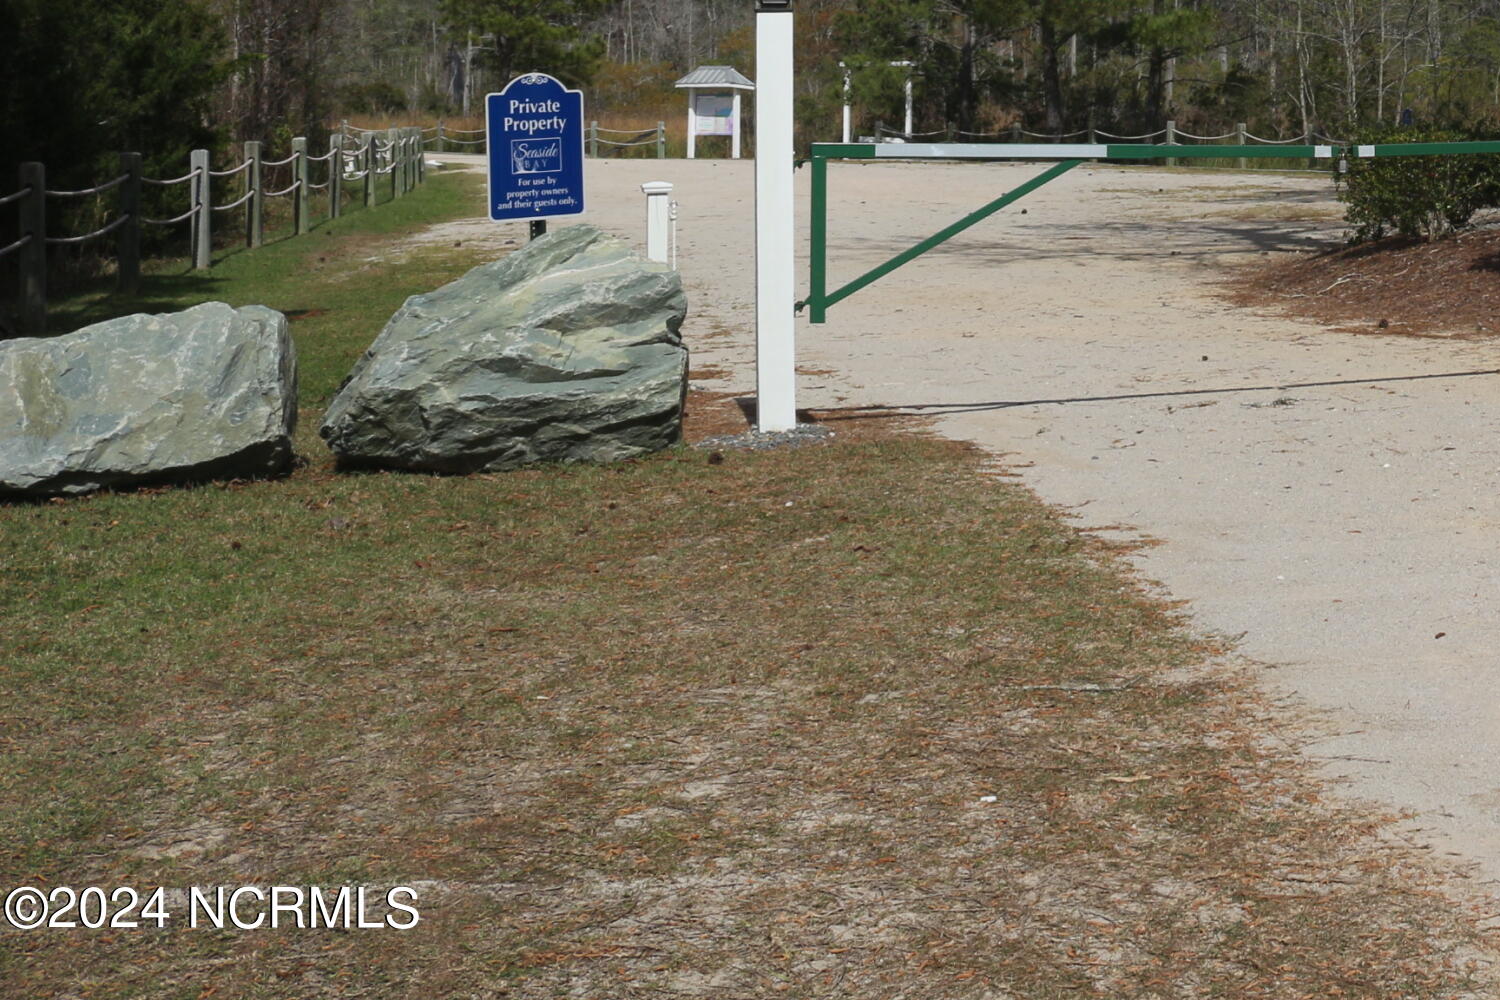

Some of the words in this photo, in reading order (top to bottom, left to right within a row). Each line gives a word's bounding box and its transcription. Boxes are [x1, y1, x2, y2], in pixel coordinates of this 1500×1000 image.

[509, 98, 560, 114] Private
[504, 116, 567, 134] Property
[513, 143, 558, 158] Seaside
[524, 159, 548, 169] BAY
[518, 178, 530, 186] For
[547, 176, 556, 185] by
[506, 189, 539, 200] property
[541, 187, 568, 196] owners
[497, 202, 513, 210] and
[514, 200, 532, 208] their
[533, 199, 557, 209] guests
[558, 197, 578, 207] only.
